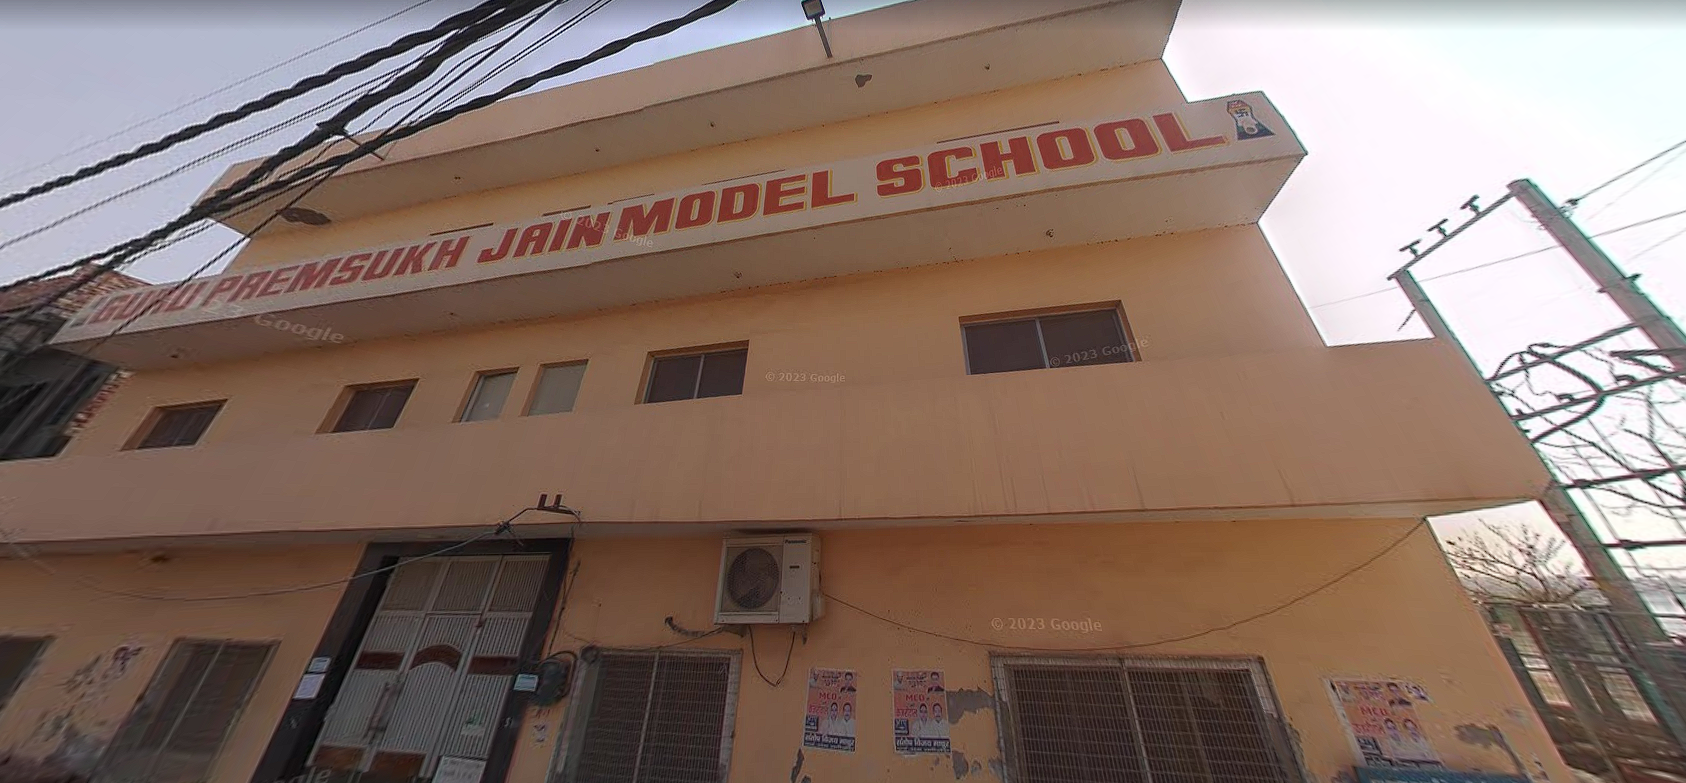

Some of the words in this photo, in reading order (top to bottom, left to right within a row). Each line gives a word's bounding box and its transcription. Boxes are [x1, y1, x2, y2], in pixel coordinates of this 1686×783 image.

[201, 236, 471, 307] PREMSUKH
[476, 211, 611, 265] JAIN
[614, 168, 857, 243] MODEL
[876, 112, 1228, 198] SCHOOL
